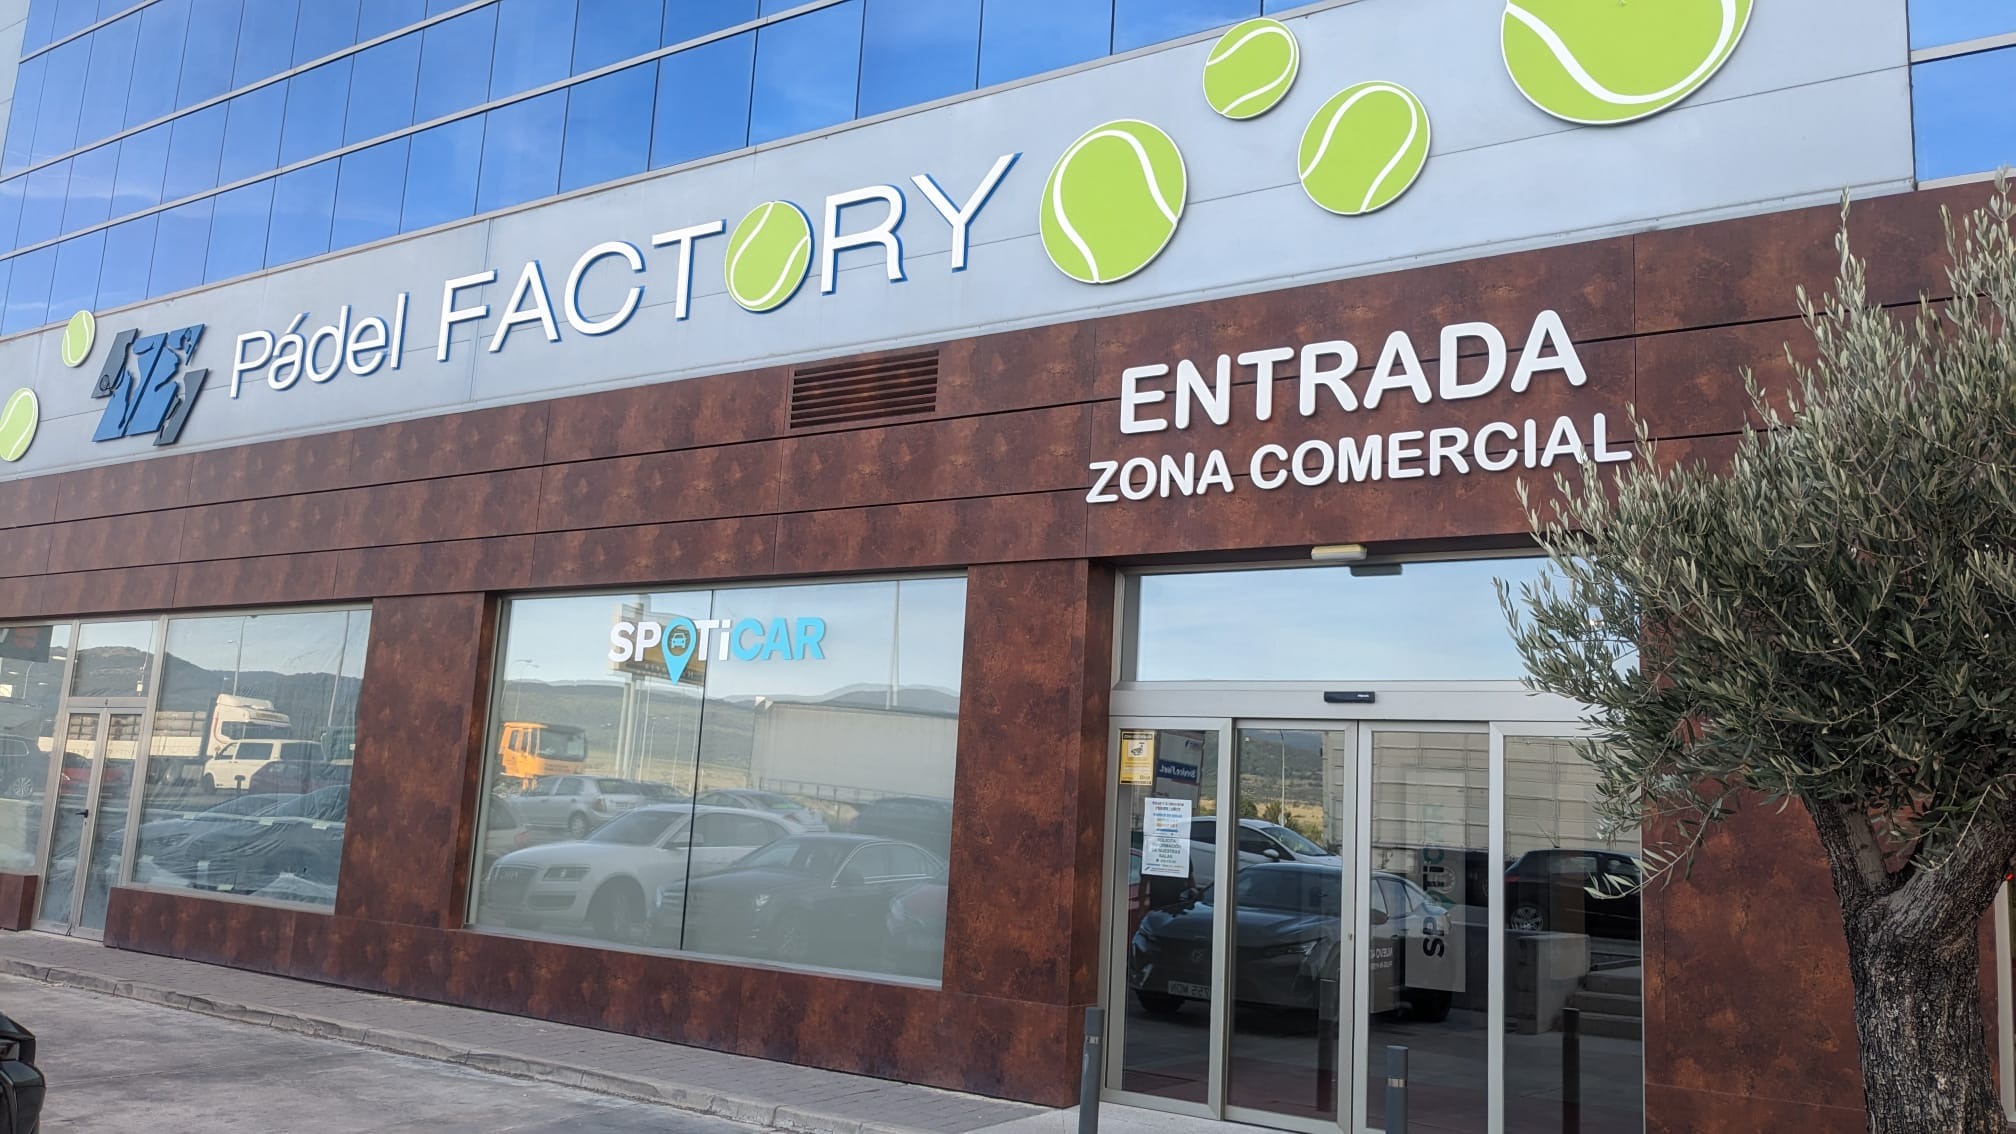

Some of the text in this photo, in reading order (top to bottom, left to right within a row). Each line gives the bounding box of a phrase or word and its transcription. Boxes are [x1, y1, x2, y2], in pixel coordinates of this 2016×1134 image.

[230, 291, 408, 398] Pádel
[1119, 309, 1588, 434] ENTRADA
[1085, 413, 1632, 503] ZONA COMERCIAL
